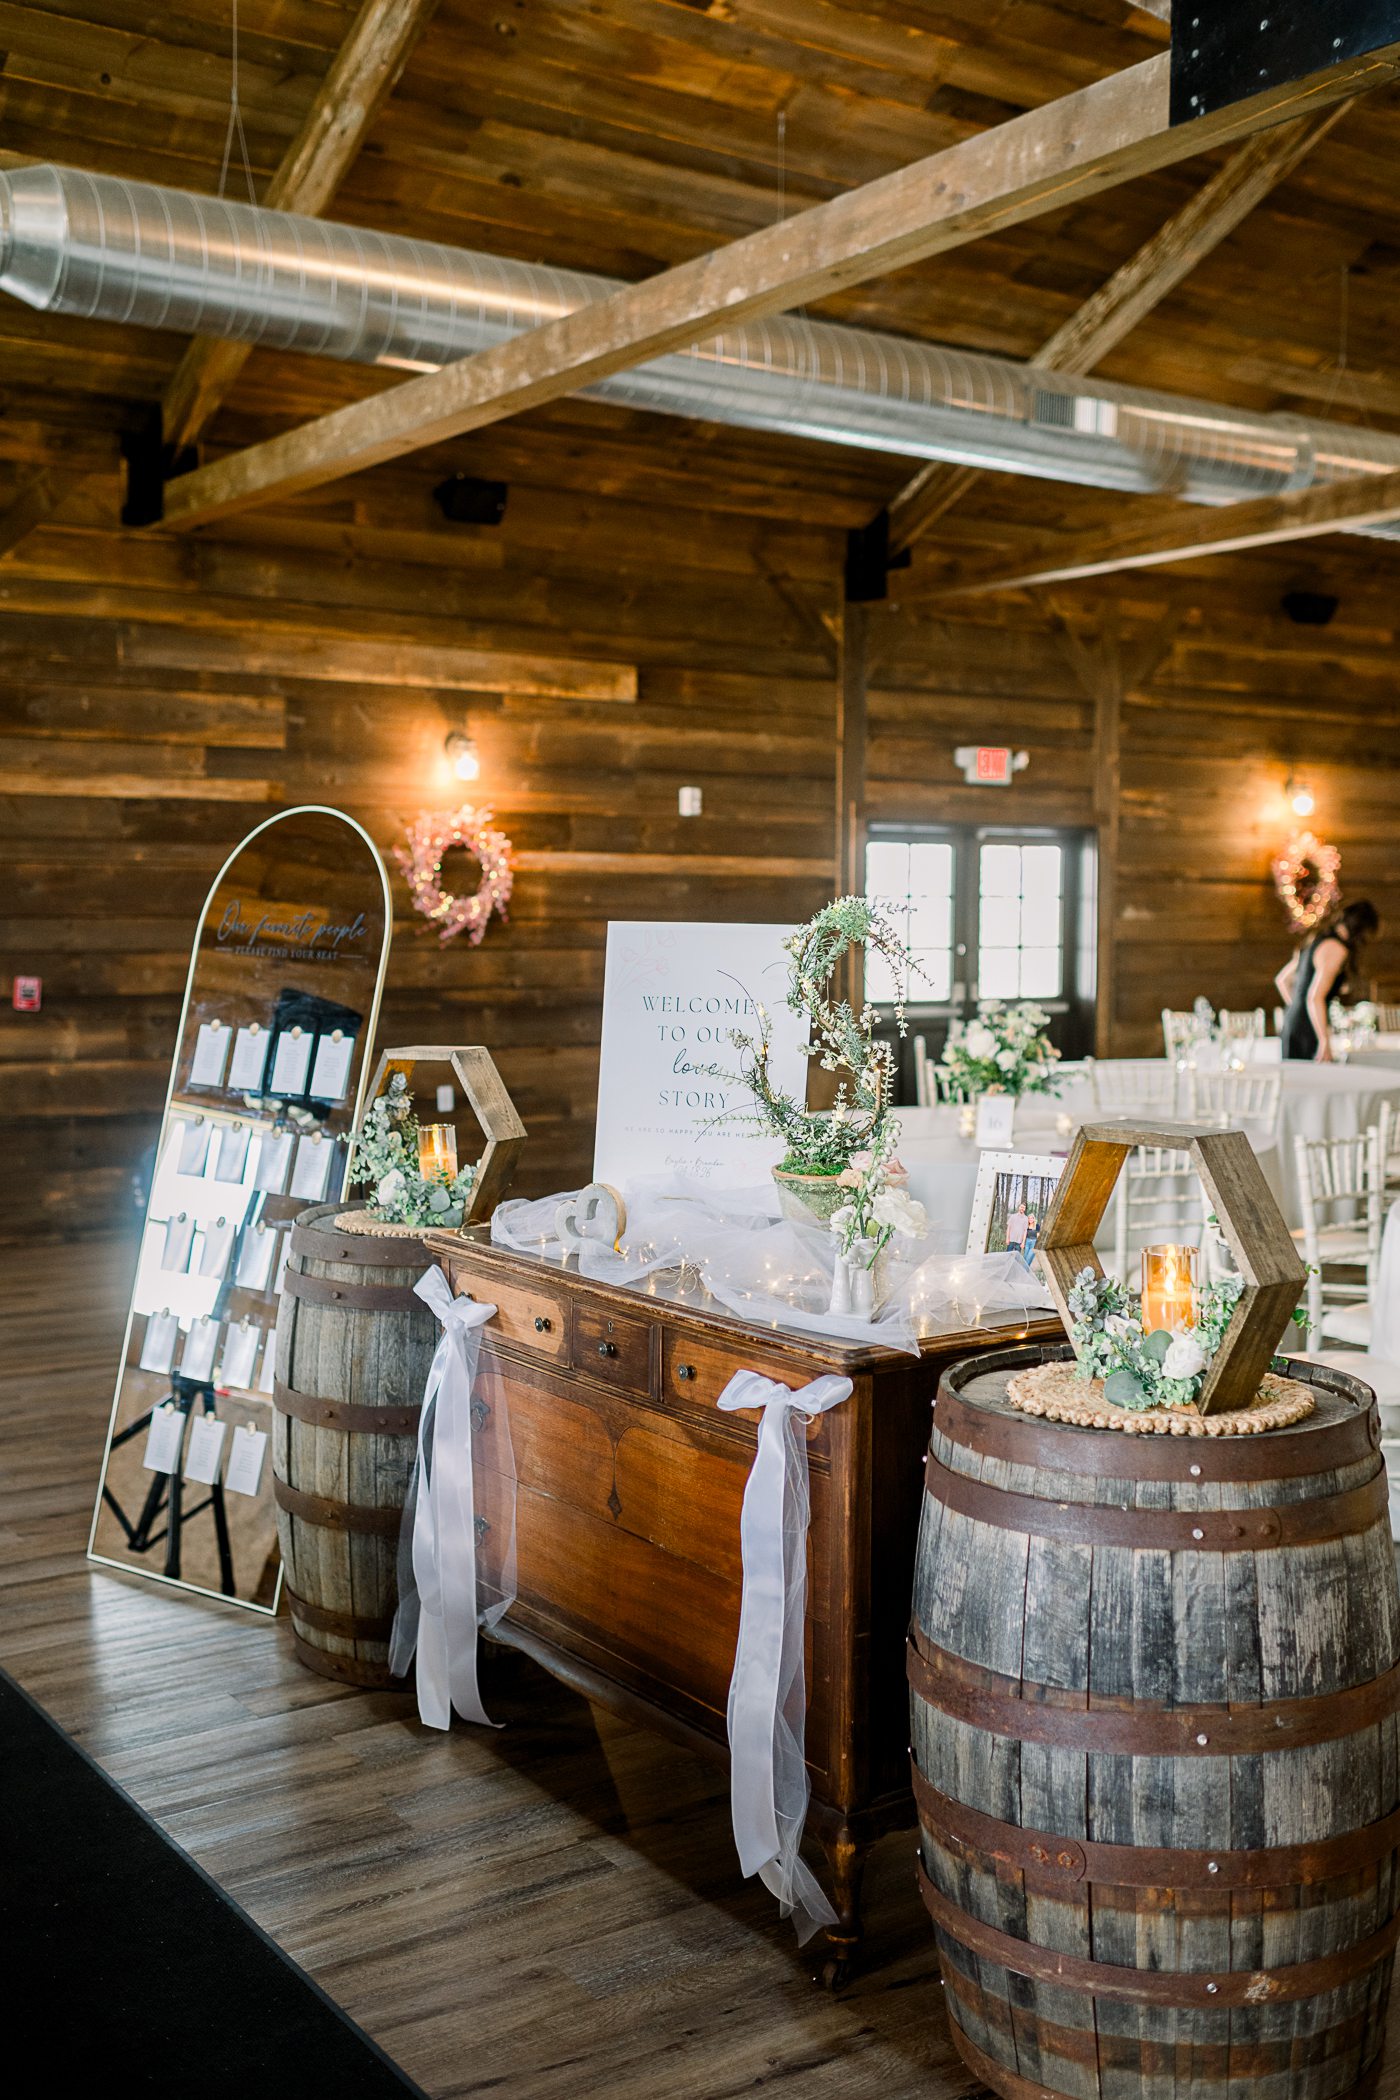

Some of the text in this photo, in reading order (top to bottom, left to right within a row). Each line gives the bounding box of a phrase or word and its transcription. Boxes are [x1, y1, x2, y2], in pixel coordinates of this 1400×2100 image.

[310, 912, 369, 948] people
[643, 996, 755, 1015] WELCOME
[658, 1025, 686, 1042] TO
[673, 1048, 719, 1075] love
[659, 1090, 730, 1109] STORY
